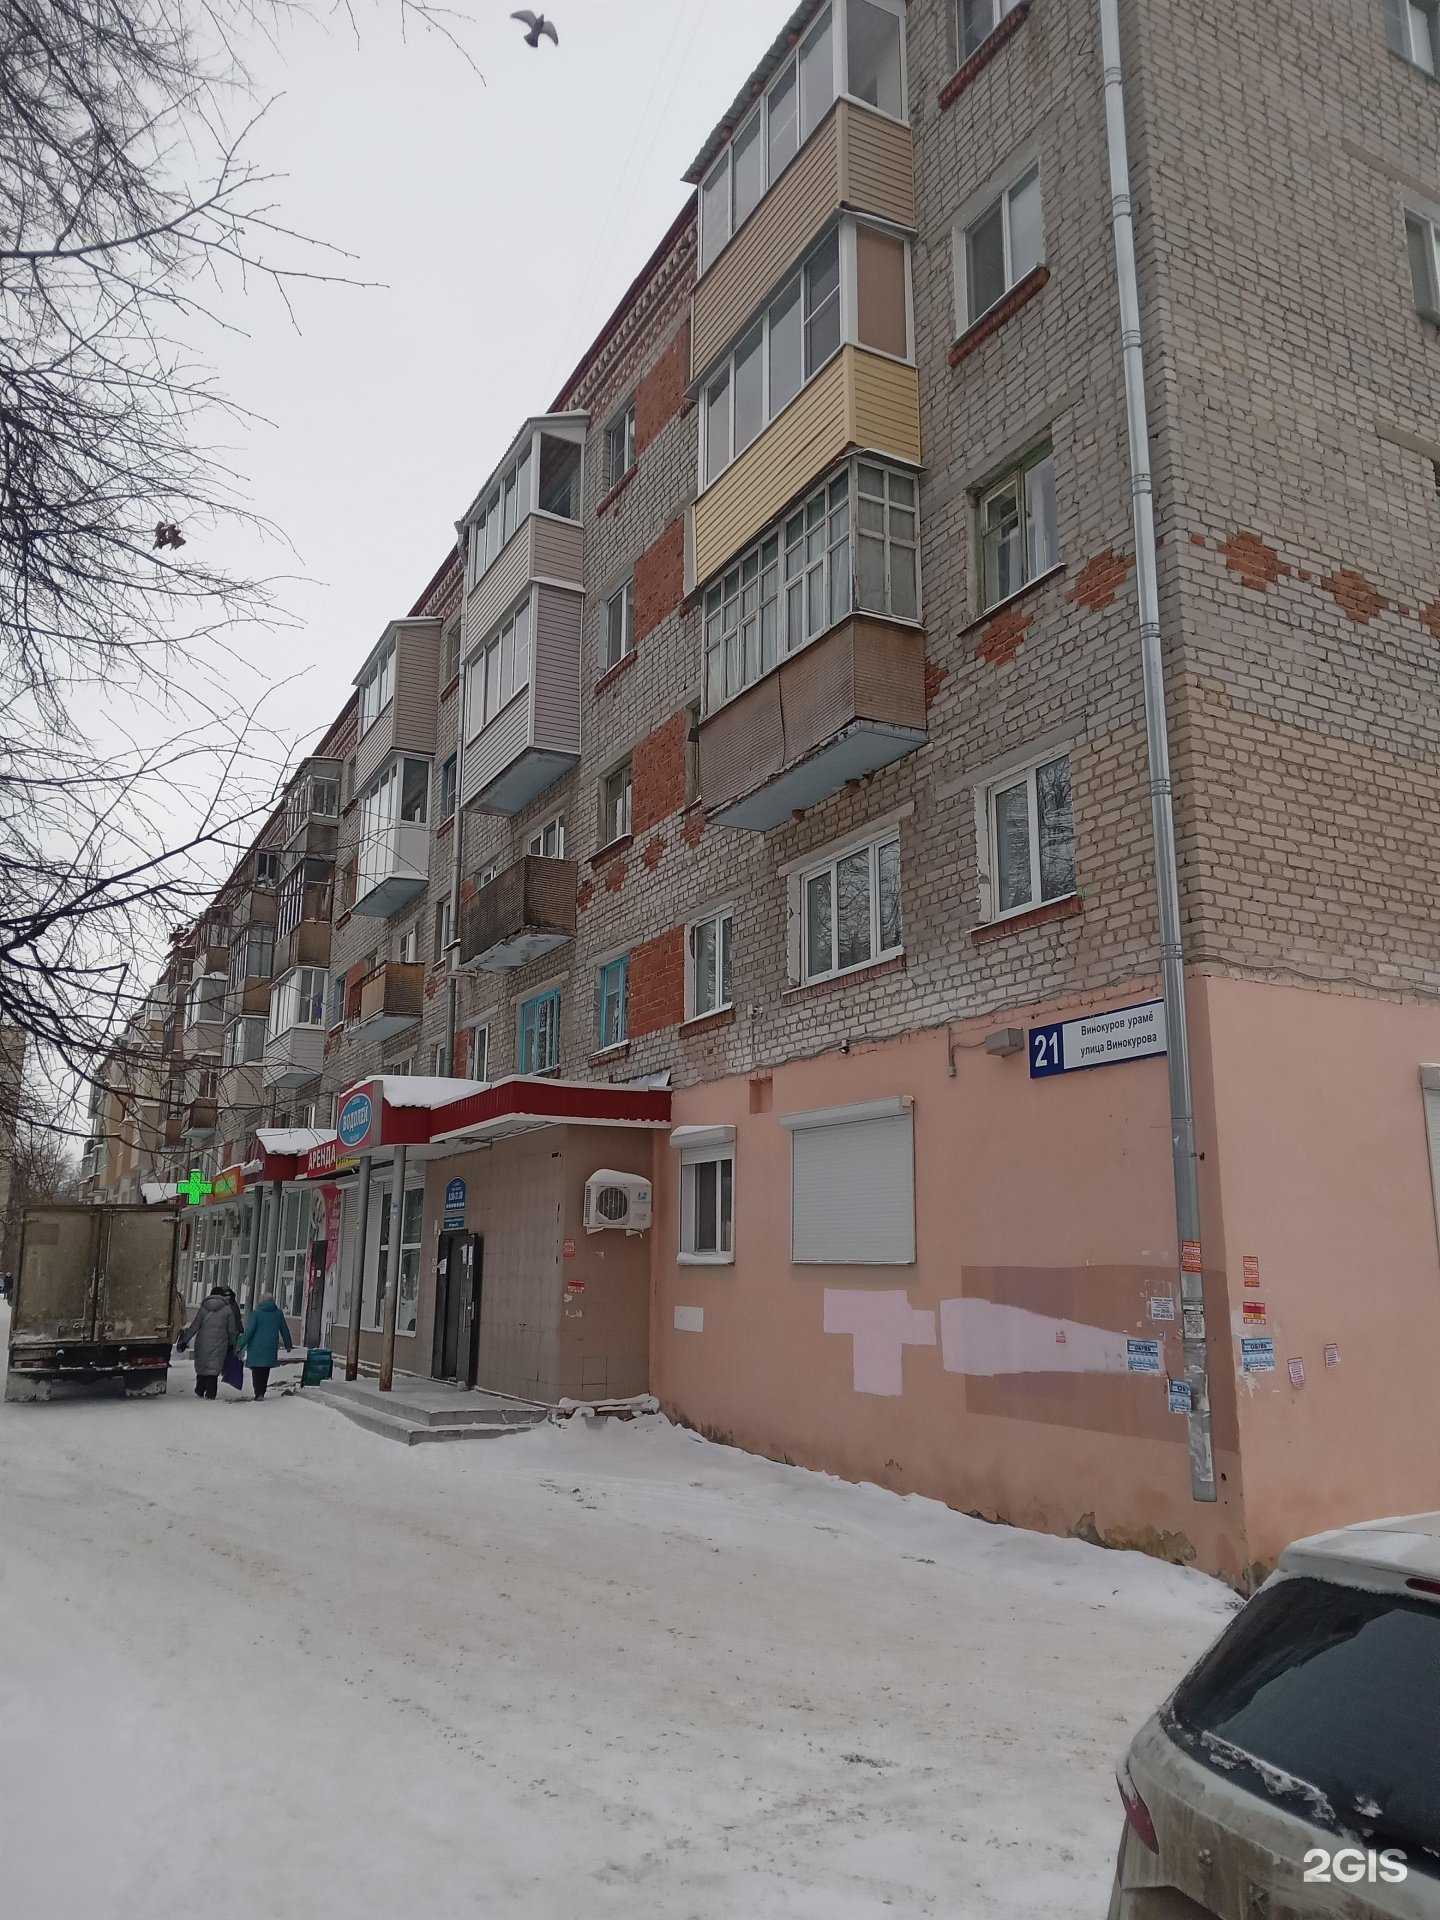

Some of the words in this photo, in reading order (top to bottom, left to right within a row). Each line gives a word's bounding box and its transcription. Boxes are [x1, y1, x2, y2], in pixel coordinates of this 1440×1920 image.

[1081, 1020, 1125, 1036] Винокуров
[1034, 1032, 1059, 1068] 21
[1080, 1043, 1105, 1058] улица
[1106, 1033, 1157, 1051] Винокурова
[308, 1143, 336, 1171] АРЕНДА
